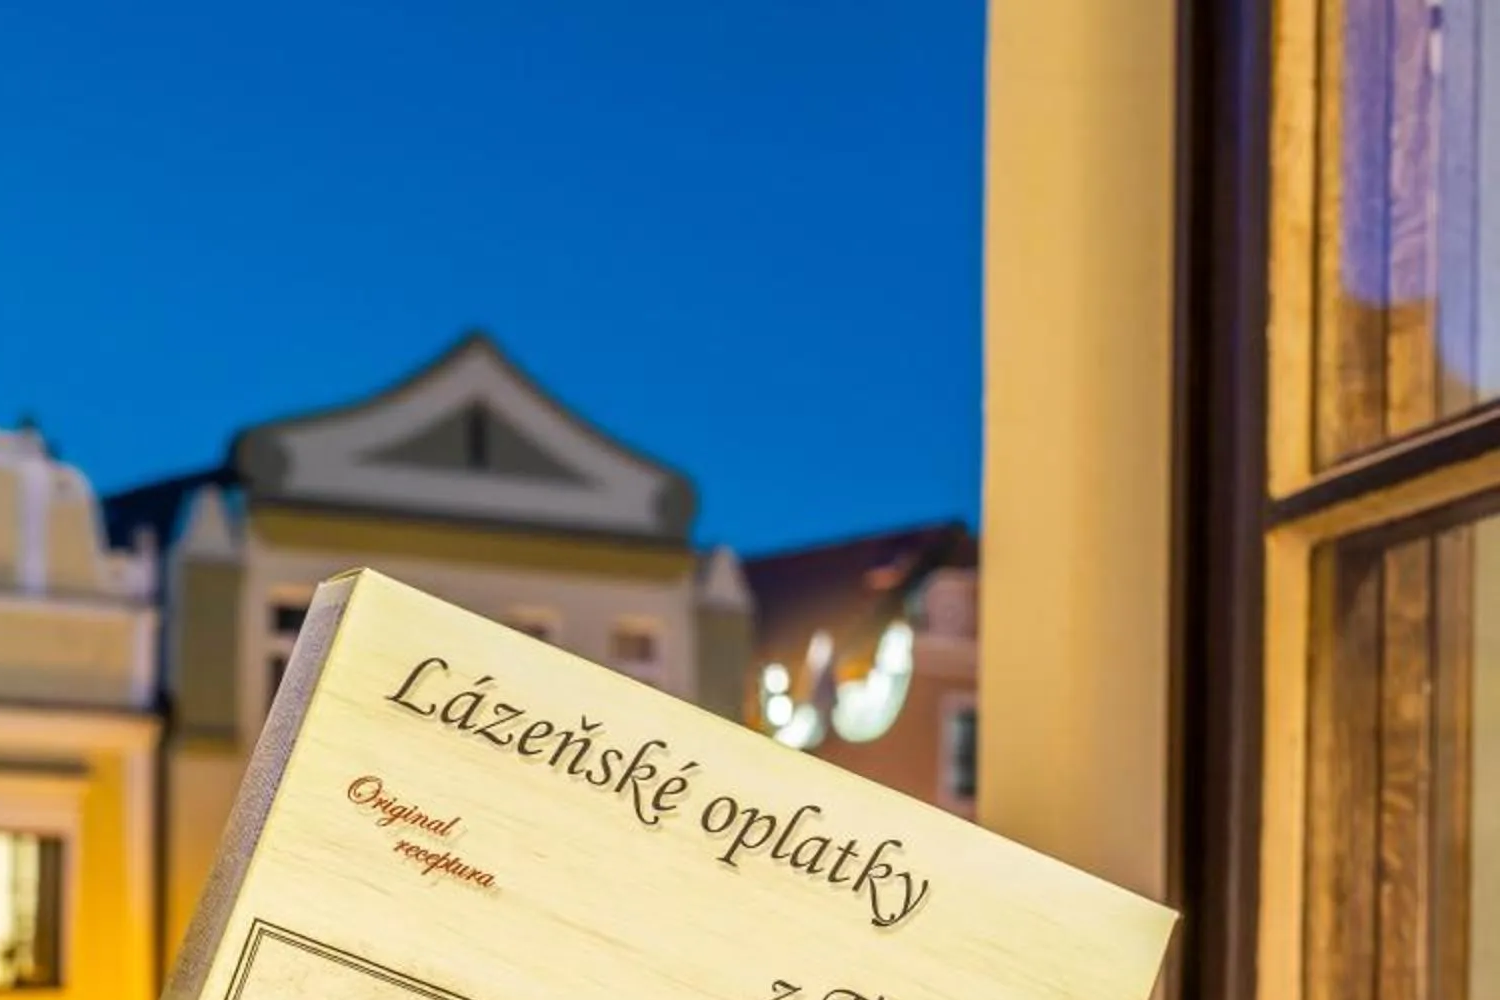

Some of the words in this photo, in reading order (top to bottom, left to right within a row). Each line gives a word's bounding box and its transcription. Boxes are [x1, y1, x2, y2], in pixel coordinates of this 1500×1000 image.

[347, 775, 462, 837] Original
[385, 657, 699, 825] Lázeňské
[701, 796, 929, 927] oplatky
[393, 839, 496, 888] receptura
